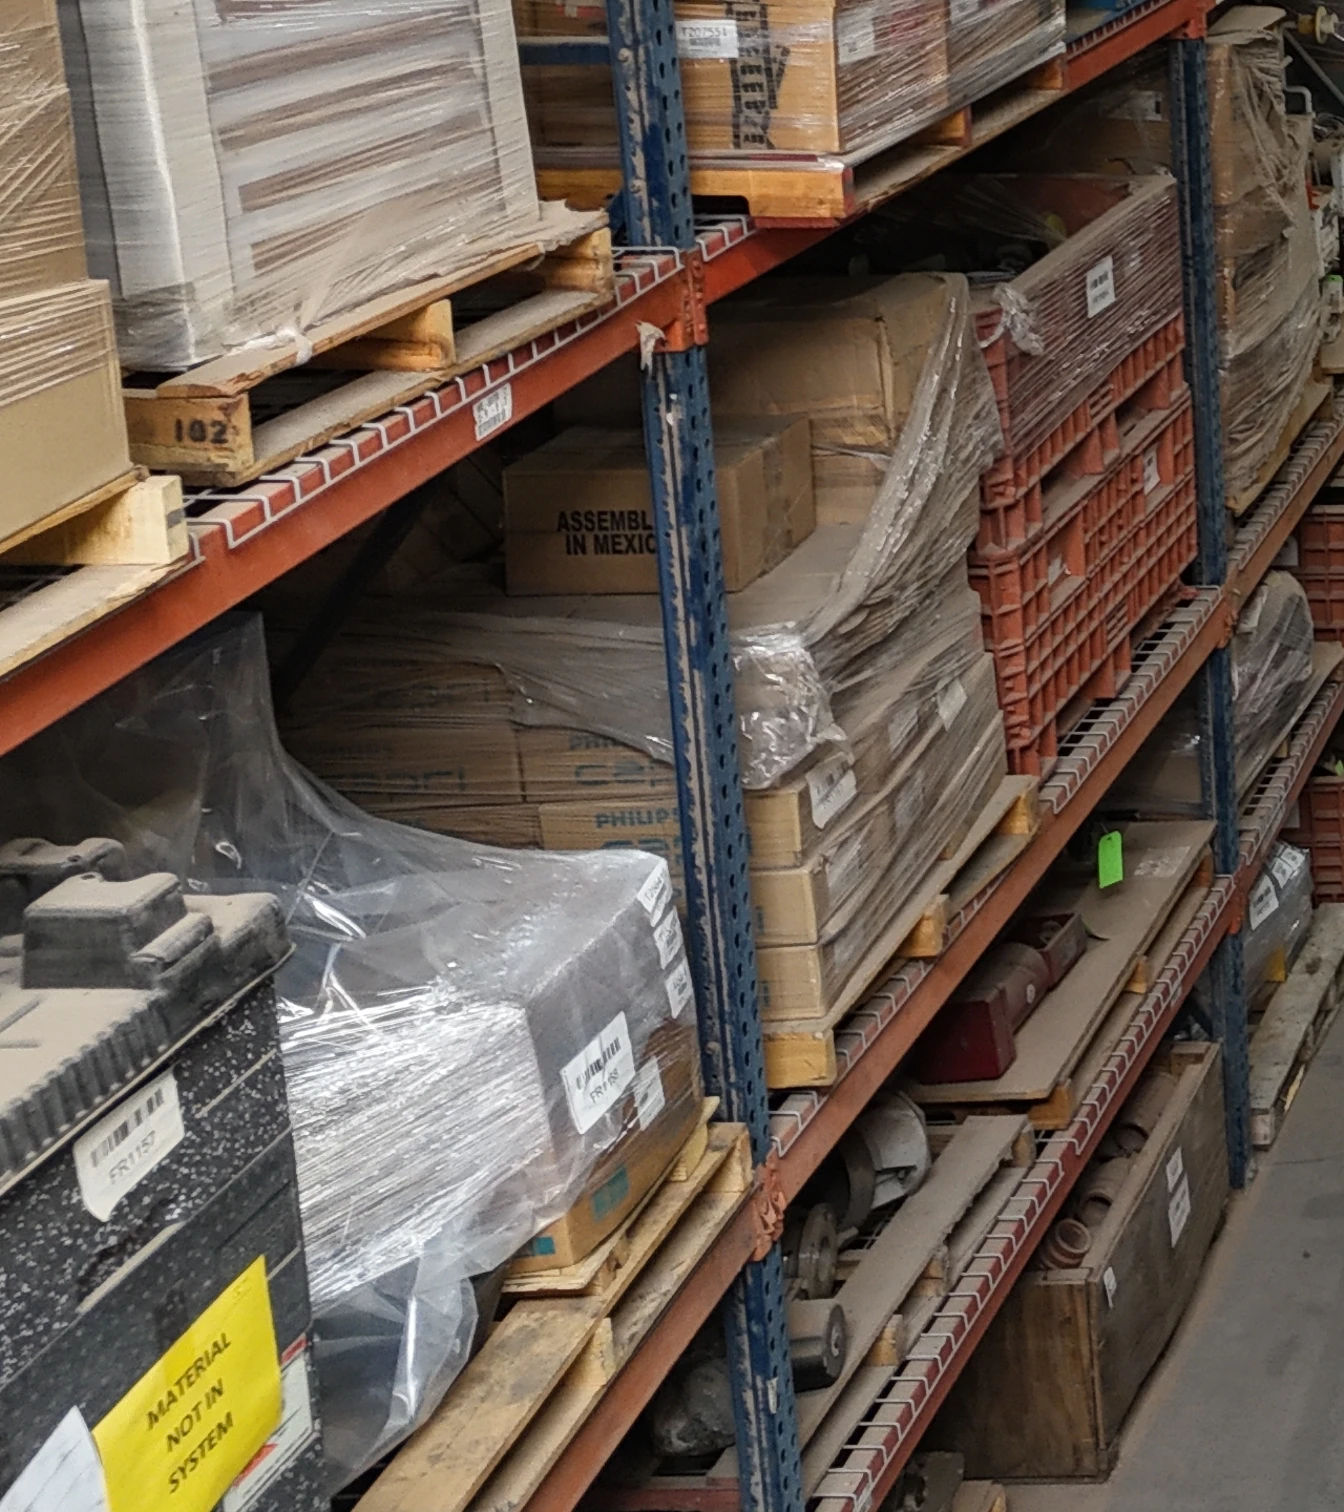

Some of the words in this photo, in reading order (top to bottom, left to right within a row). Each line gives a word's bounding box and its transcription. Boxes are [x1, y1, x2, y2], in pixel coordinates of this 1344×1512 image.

[557, 510, 653, 532] ASSEMBL
[565, 534, 587, 555] IN
[594, 533, 657, 555] MEXIC
[146, 1332, 231, 1431] MATERIAL
[166, 1400, 205, 1452] NOT
[205, 1378, 224, 1411] IN
[168, 1411, 234, 1495] SYSTEM
